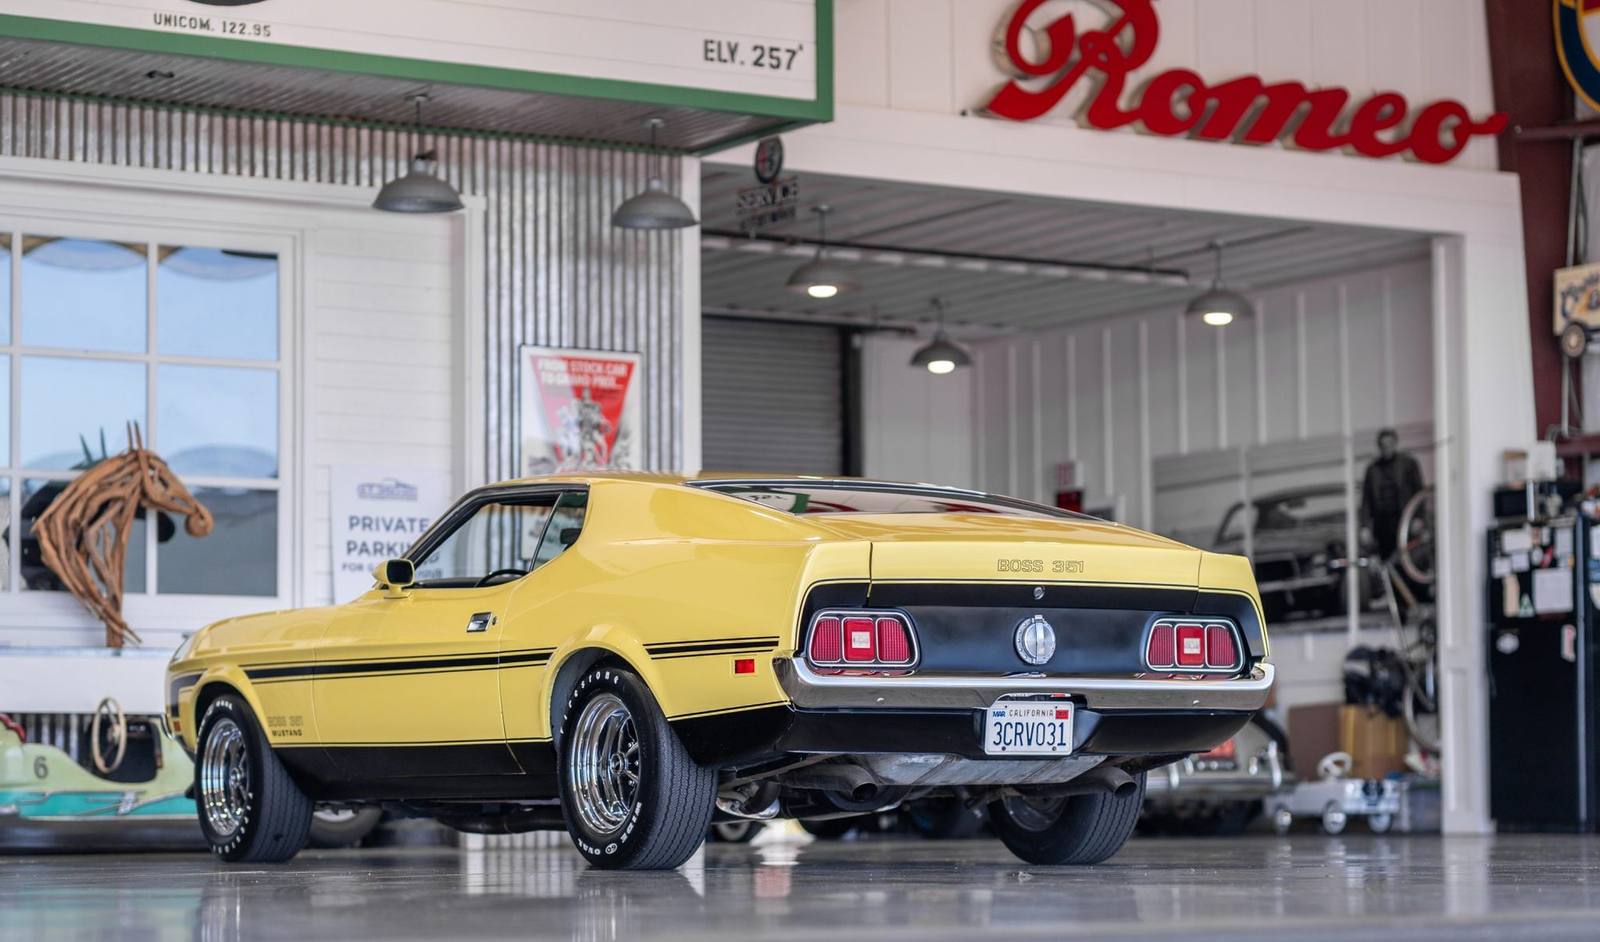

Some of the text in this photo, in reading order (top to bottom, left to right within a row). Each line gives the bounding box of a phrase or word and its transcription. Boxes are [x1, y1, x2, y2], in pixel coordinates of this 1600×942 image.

[153, 12, 272, 37] UNICOM. 122.95
[986, 0, 1509, 164] Romeo
[348, 515, 430, 533] PRIVATE
[997, 559, 1085, 573] BOSS 351
[1009, 709, 1054, 718] CALIFORNIA
[993, 721, 1067, 747] 3CRV031
[33, 755, 49, 779] 6
